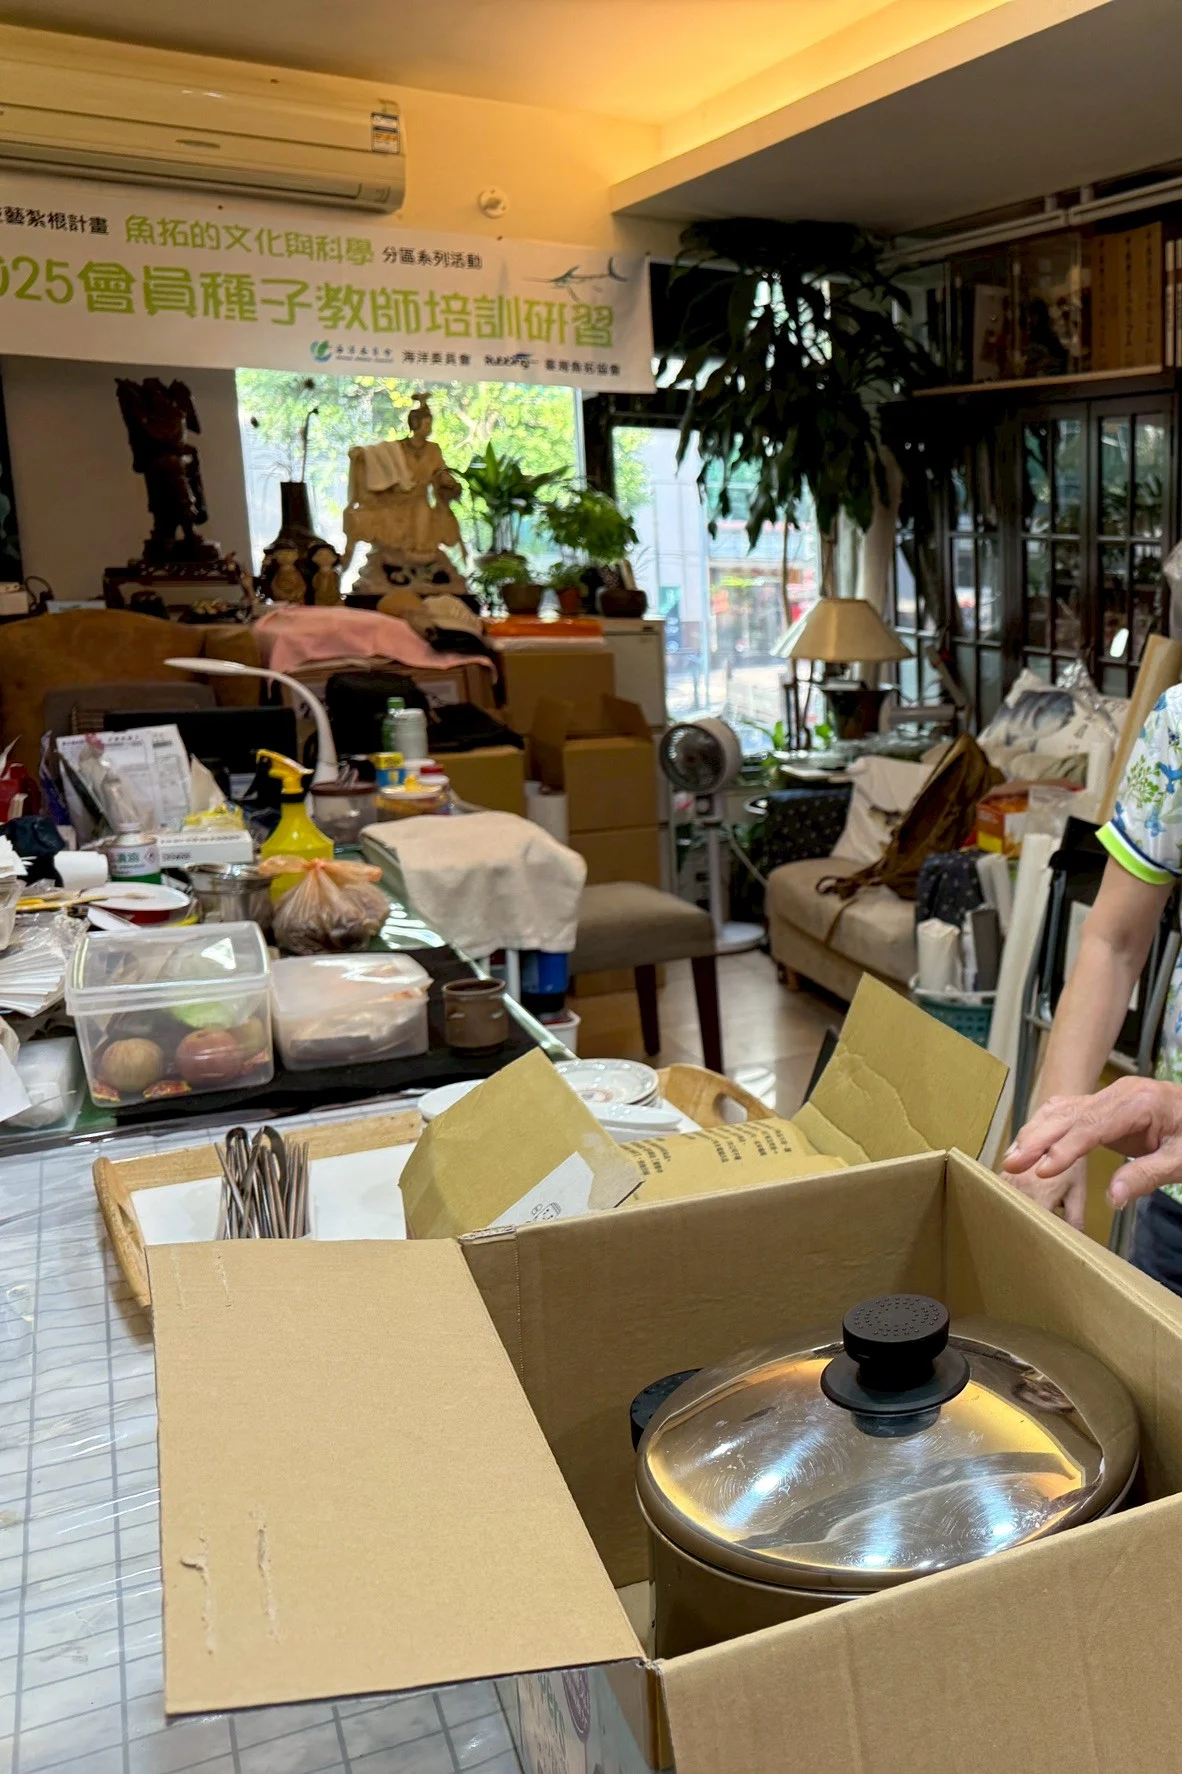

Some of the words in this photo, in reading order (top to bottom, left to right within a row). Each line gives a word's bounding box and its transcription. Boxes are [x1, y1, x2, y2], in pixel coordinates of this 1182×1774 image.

[0, 205, 109, 236] 藝紮根計畫
[125, 214, 374, 266] 魚拓的文化與科學
[382, 246, 483, 270] 分區系列活動
[402, 350, 471, 367] 海洋委員會
